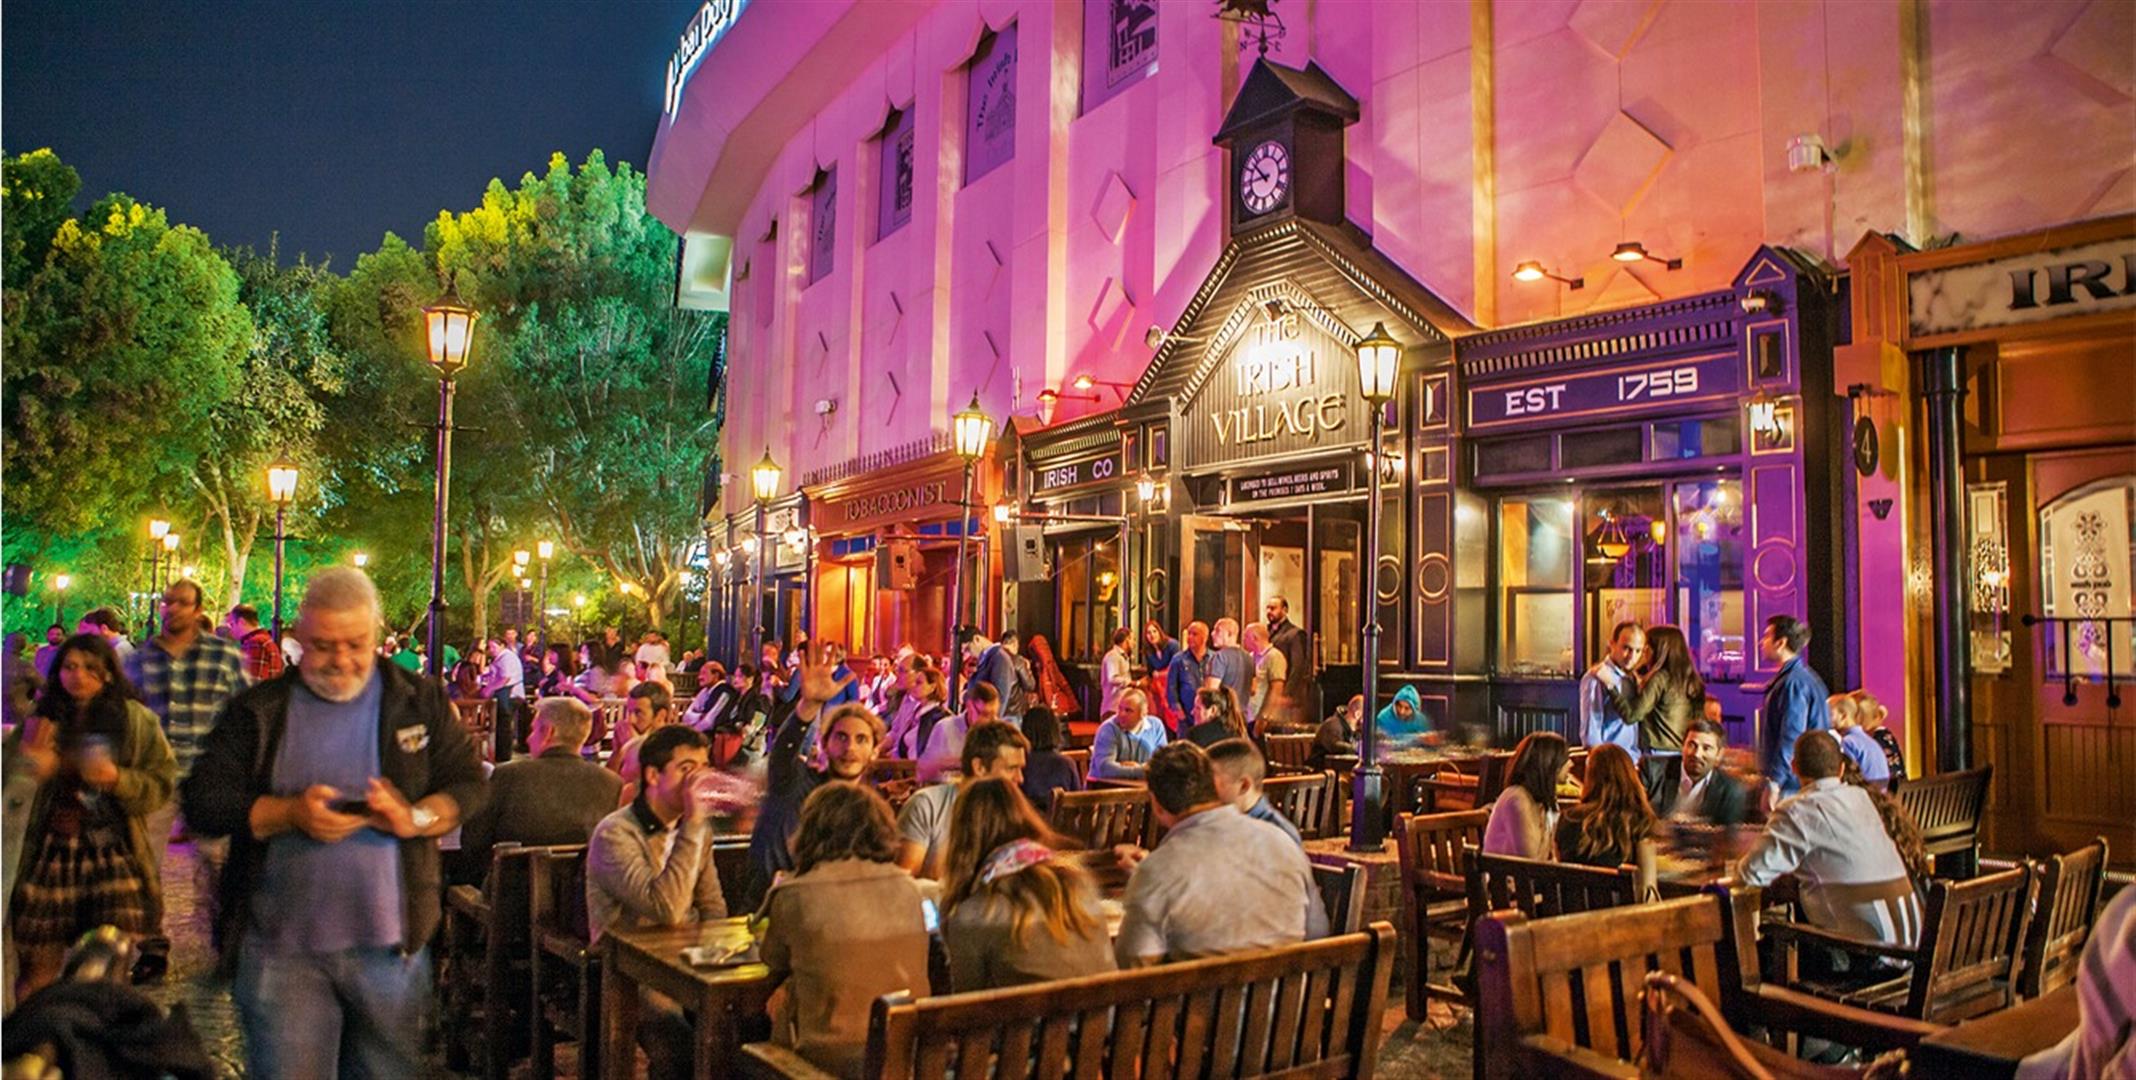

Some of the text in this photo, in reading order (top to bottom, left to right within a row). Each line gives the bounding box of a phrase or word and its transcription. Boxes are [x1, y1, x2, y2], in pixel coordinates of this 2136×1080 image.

[1237, 351, 1315, 398] IRISH
[1505, 366, 1699, 416] EST 1759
[1210, 392, 1347, 446] VILLAGE
[1860, 428, 1872, 464] 4
[1043, 458, 1113, 489] IRISH CO
[843, 480, 947, 521] TOBACCONIST
